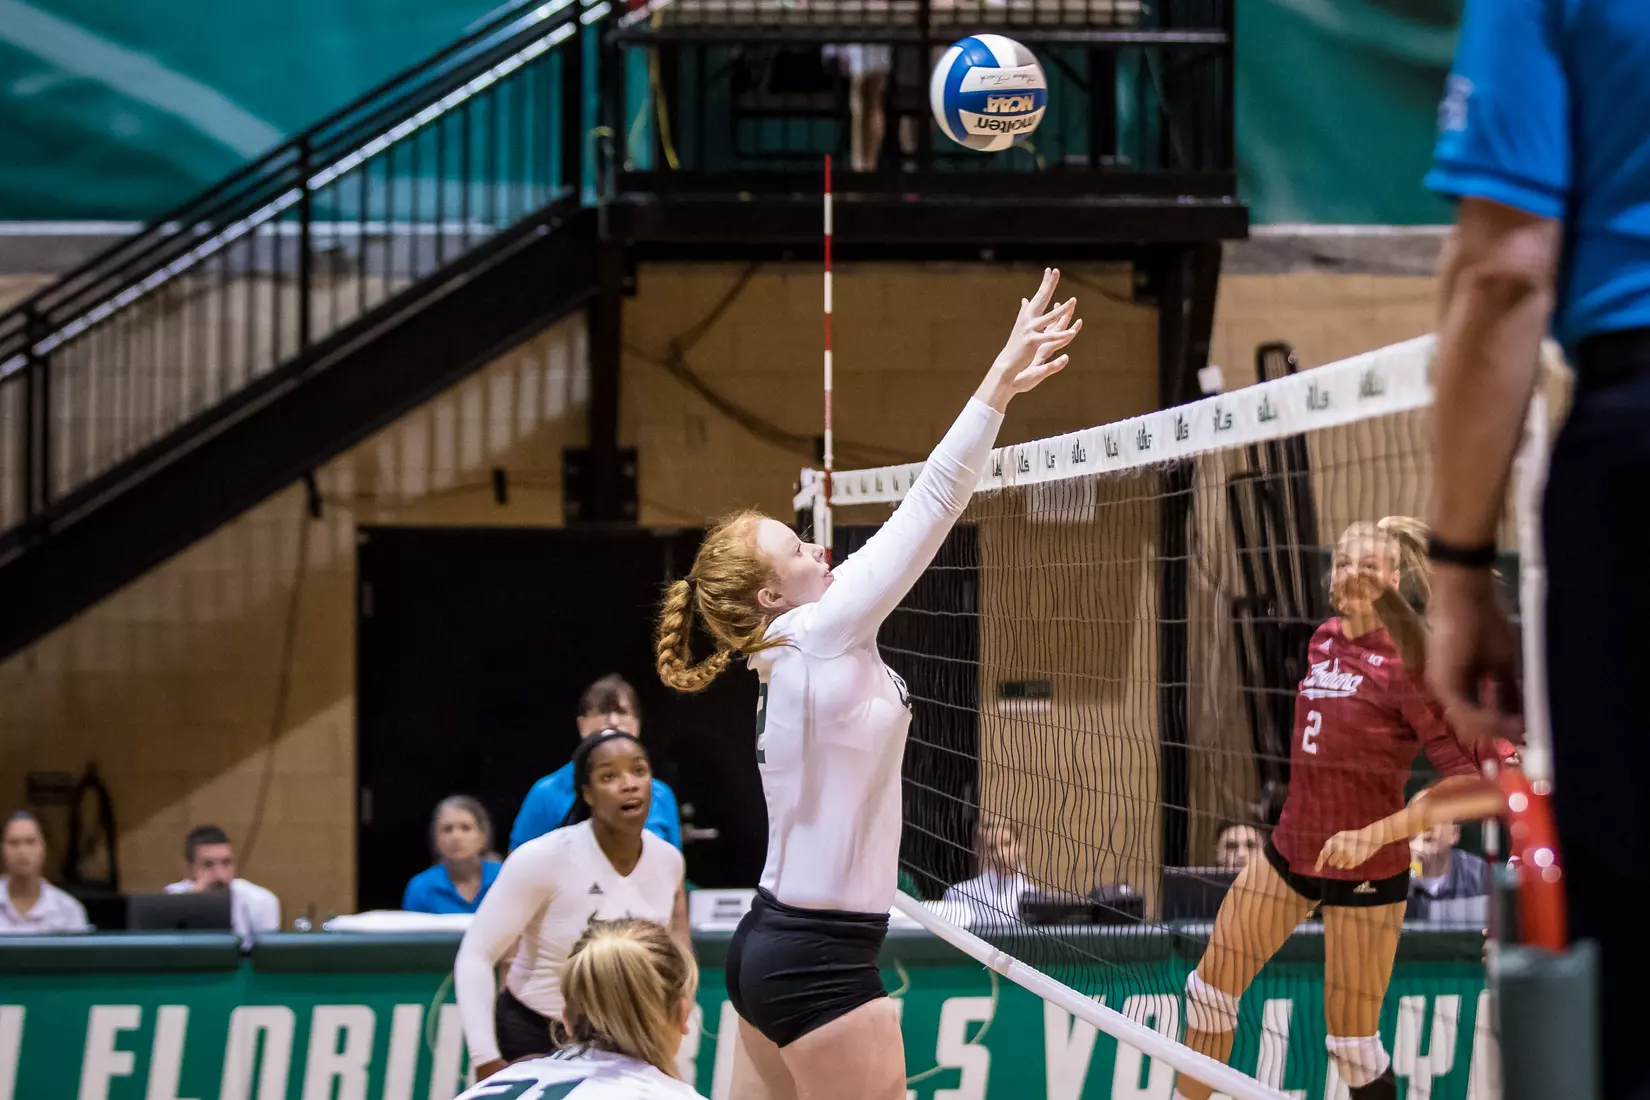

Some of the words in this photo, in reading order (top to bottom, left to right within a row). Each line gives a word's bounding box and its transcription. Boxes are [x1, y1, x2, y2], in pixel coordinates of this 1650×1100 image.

[987, 94, 1034, 112] NCAA
[977, 116, 1036, 133] molten
[1303, 710, 1322, 755] 2
